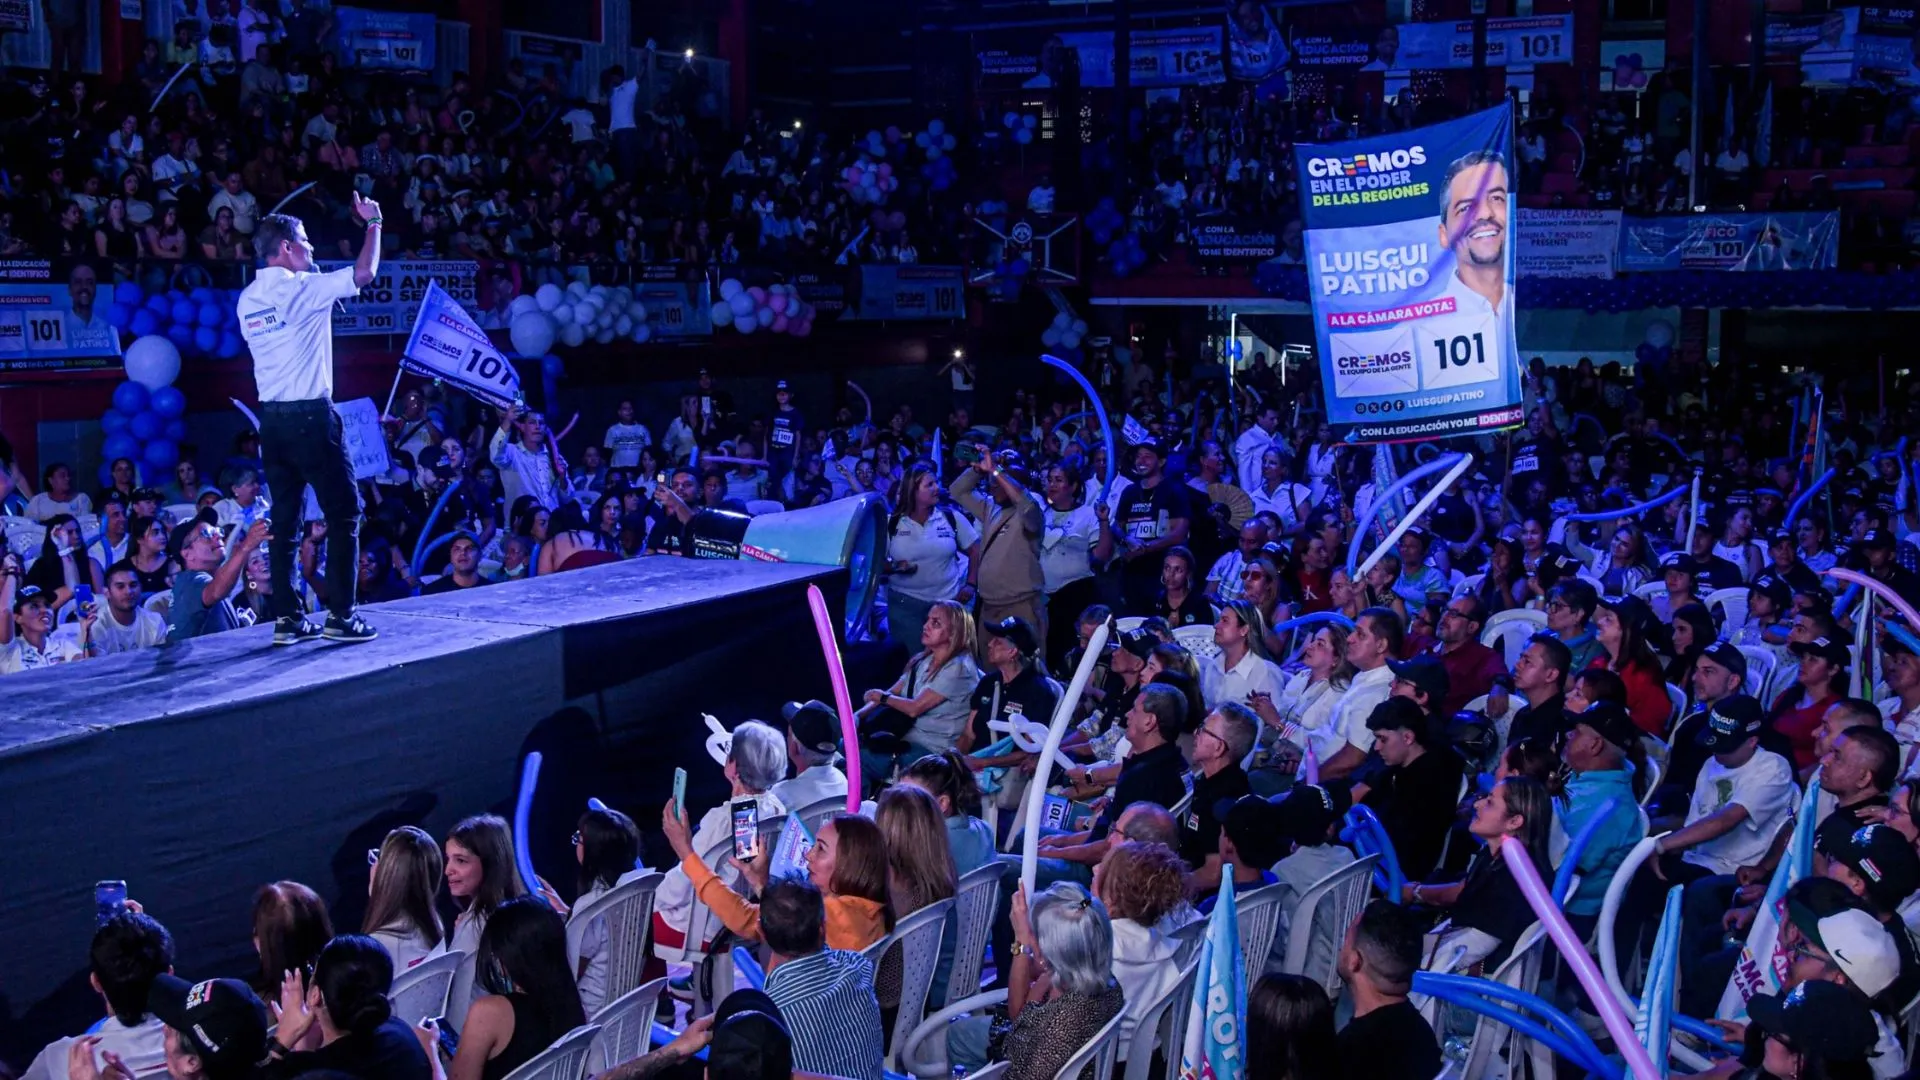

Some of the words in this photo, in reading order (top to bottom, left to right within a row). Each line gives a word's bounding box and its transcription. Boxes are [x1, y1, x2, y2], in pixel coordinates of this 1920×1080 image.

[394, 48, 414, 61] 101
[1300, 40, 1369, 55] EDUCACIÓN
[1521, 34, 1560, 58] 101
[1308, 146, 1427, 177] CREEMOS
[1310, 179, 1333, 193] EN
[1336, 177, 1354, 192] EL
[1356, 170, 1411, 190] PODER
[1312, 195, 1332, 207] DE
[1333, 192, 1360, 205] LAS
[1361, 182, 1429, 203] REGIONES
[1198, 230, 1276, 245] EDUCACIÓN
[1205, 226, 1223, 234] CON
[1198, 248, 1210, 256] YO
[1223, 248, 1275, 256] IDENTIFICO
[1319, 243, 1428, 273] LUISGUI
[1714, 243, 1742, 256] 101
[12, 258, 51, 267] EDUCACIÓN
[431, 263, 480, 272] IDENTIFICO
[9, 270, 50, 278] IDENTIFICO
[1321, 265, 1430, 296] PATIÑO
[935, 288, 956, 312] 101
[264, 315, 276, 325] 101
[367, 316, 392, 327] 101
[664, 308, 682, 324] 101
[1331, 318, 1340, 326] A
[1341, 315, 1356, 326] LA
[1357, 307, 1414, 325] CÁMARA
[1416, 301, 1453, 316] VOTA:
[31, 319, 61, 341] 101
[1434, 332, 1485, 370] 101
[466, 348, 513, 386] 101
[1338, 351, 1412, 369] CREEMOS
[1347, 367, 1371, 376] EQUIPO
[1372, 366, 1380, 374] DE
[1390, 364, 1412, 372] GENTE
[1408, 390, 1485, 408] LUISGUIPATINO
[1361, 428, 1382, 437] CON
[1383, 426, 1395, 436] LA
[1395, 420, 1449, 435] EDUCACIÓN
[1450, 418, 1463, 428] YO
[1464, 416, 1477, 426] ME
[1140, 525, 1153, 534] 101
[1049, 803, 1062, 820] 101
